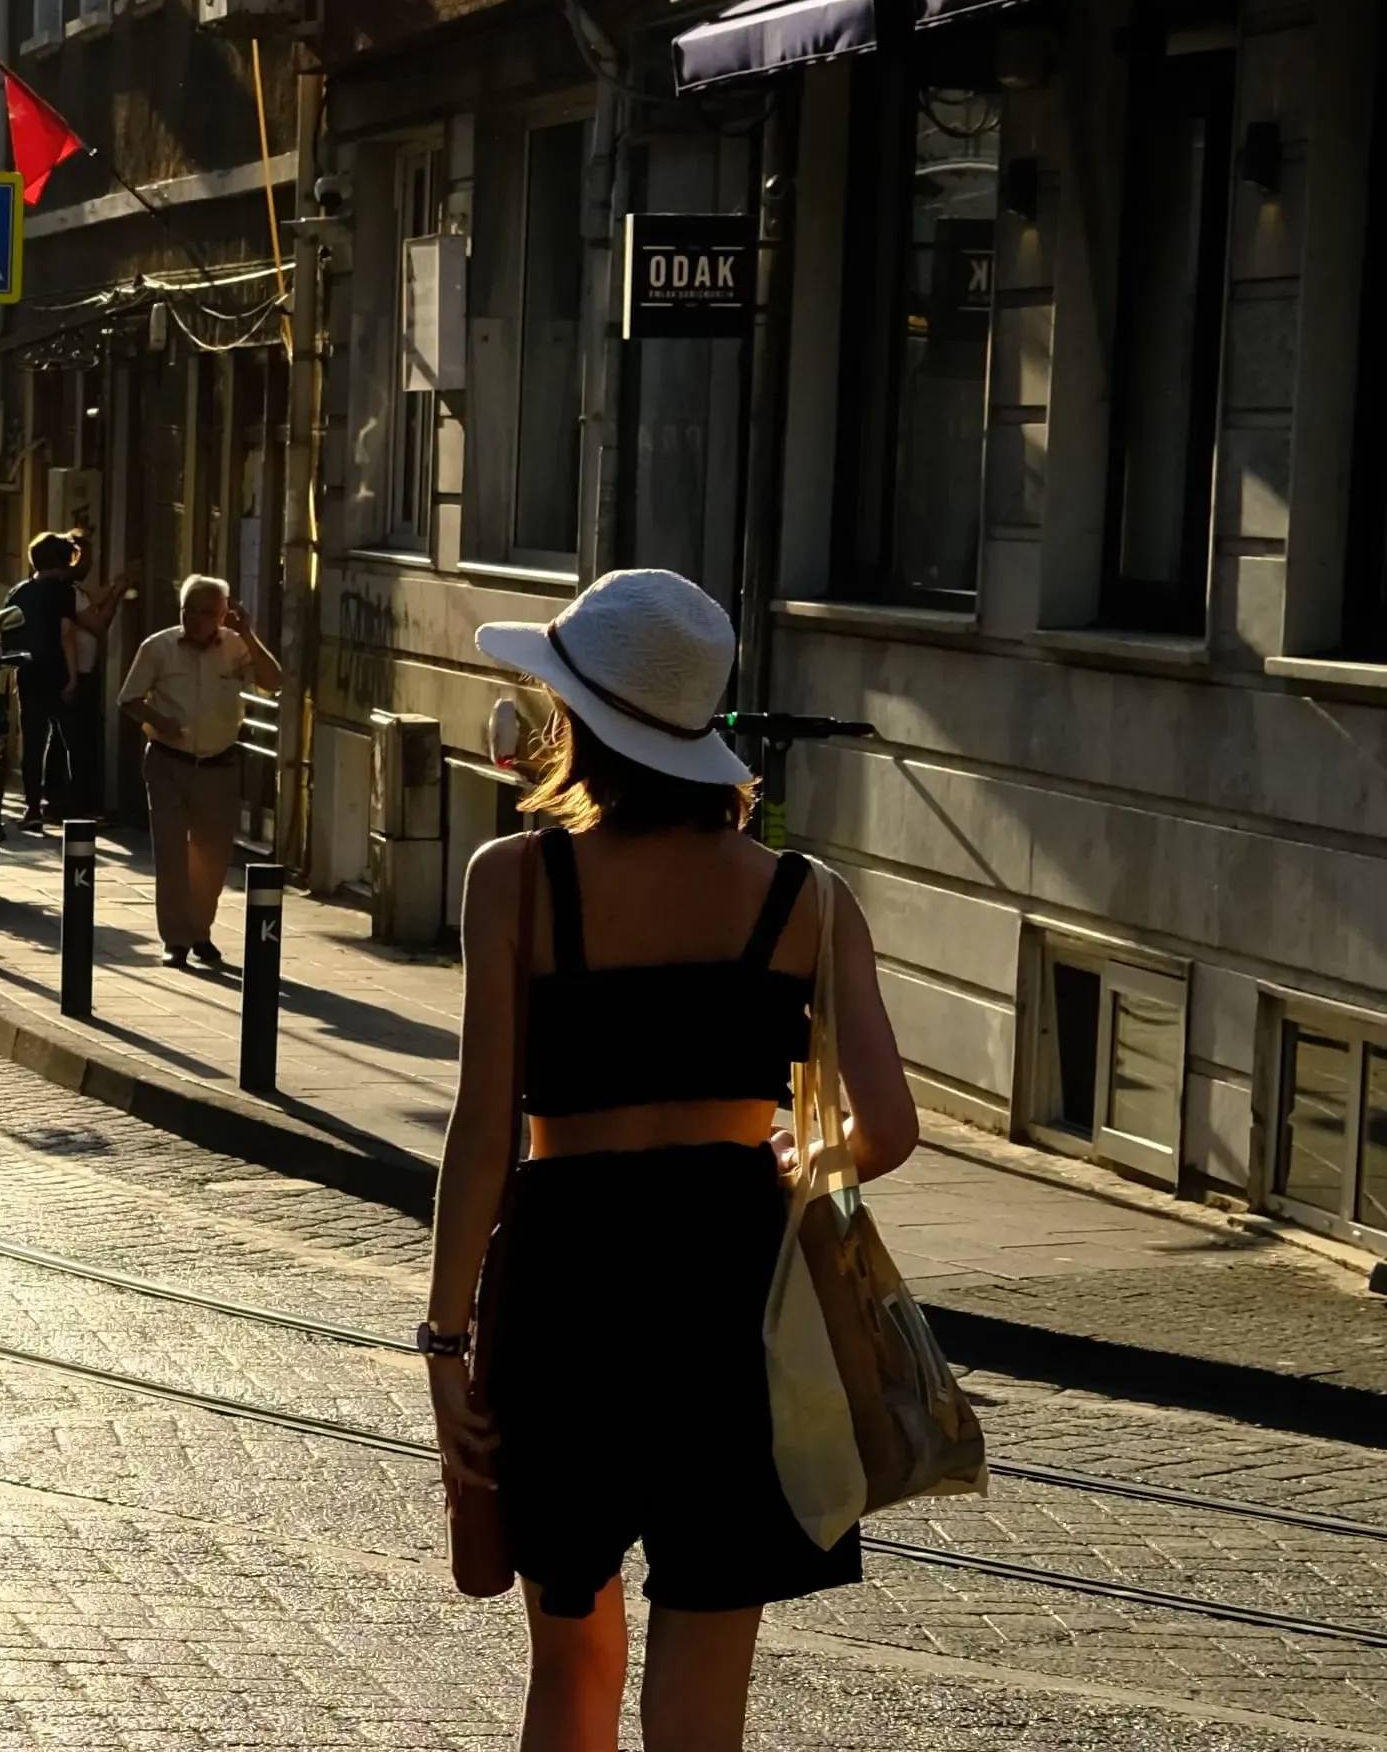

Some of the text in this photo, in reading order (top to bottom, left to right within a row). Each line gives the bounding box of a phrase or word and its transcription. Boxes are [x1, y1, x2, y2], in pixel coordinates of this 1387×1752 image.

[649, 255, 736, 288] ODAK
[73, 868, 91, 888] K
[260, 919, 279, 942] K
